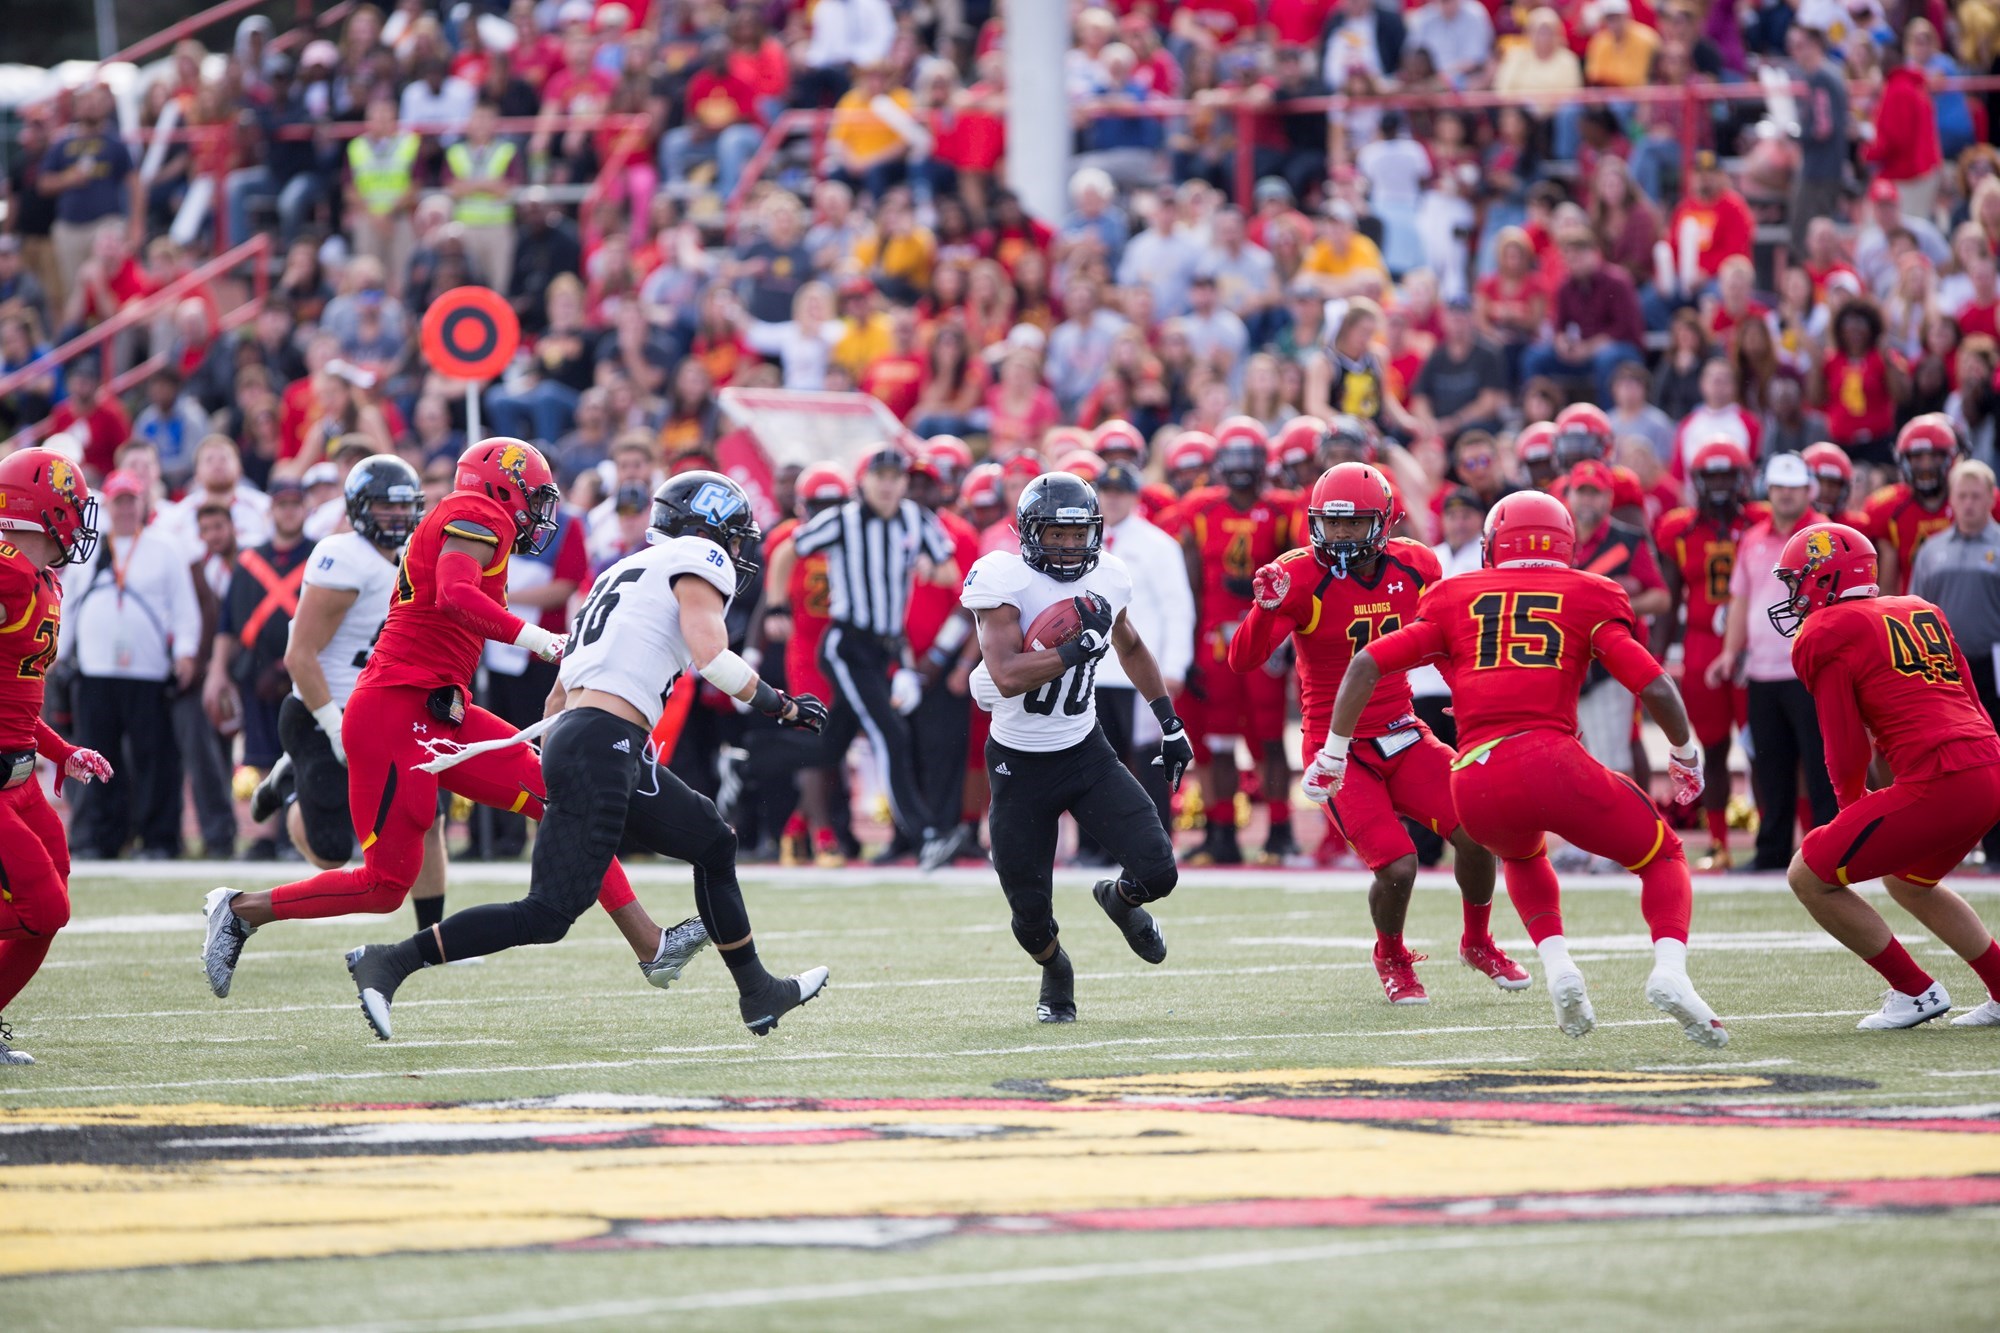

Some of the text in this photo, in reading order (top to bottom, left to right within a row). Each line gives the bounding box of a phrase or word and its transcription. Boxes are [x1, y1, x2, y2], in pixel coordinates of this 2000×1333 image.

[690, 482, 744, 527] GV
[706, 549, 725, 567] 36
[562, 568, 647, 659] 36
[1353, 602, 1391, 615] BULLDOGS
[1468, 592, 1564, 670] 15
[17, 617, 61, 678] 2
[1882, 610, 1963, 685] 49
